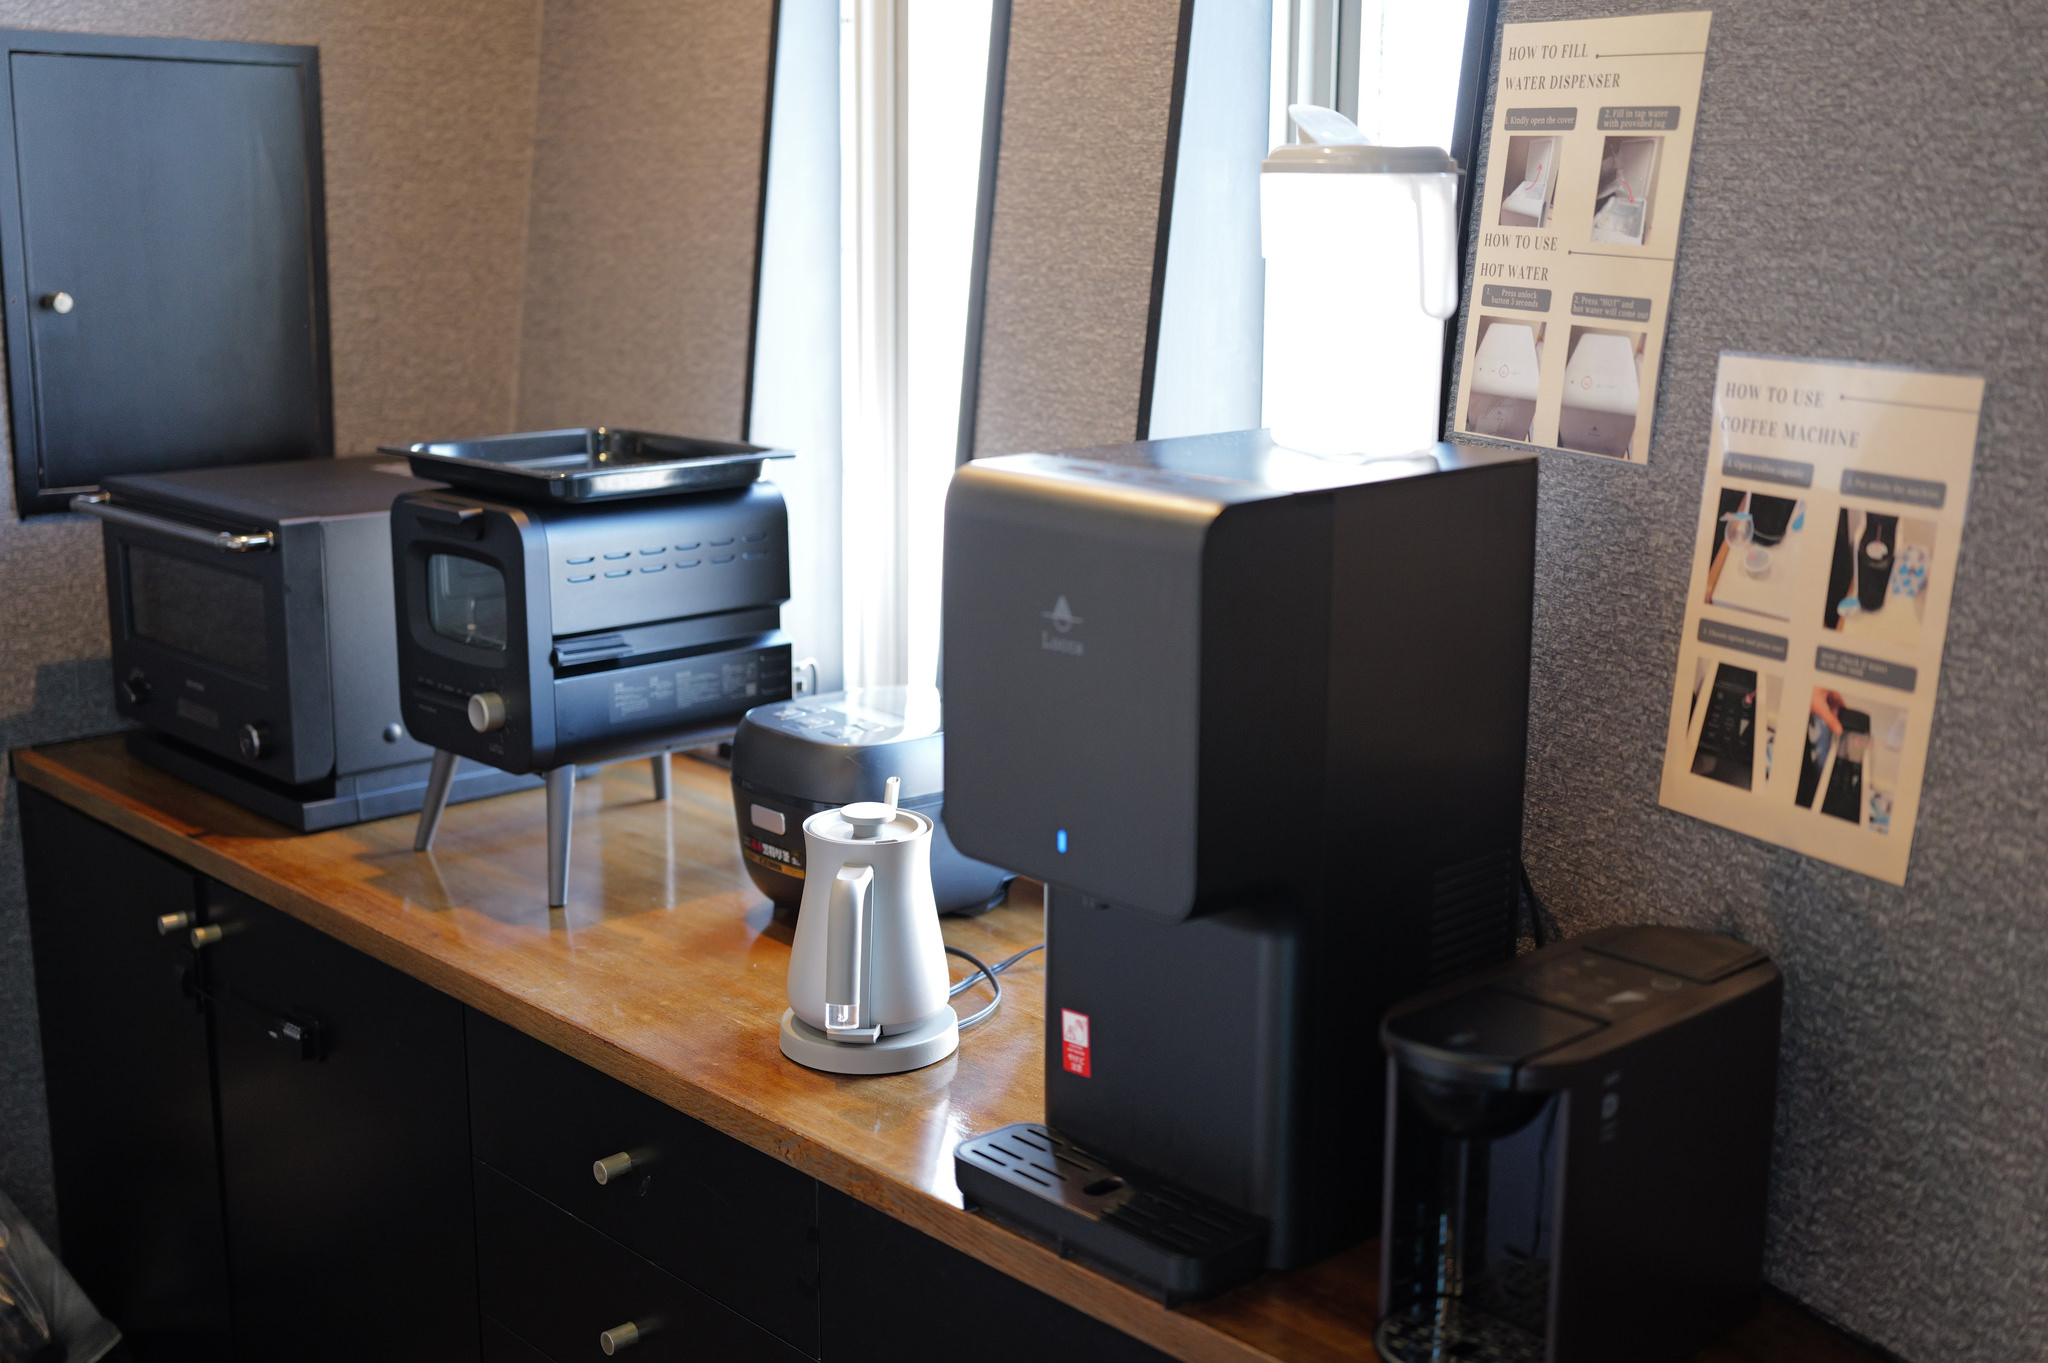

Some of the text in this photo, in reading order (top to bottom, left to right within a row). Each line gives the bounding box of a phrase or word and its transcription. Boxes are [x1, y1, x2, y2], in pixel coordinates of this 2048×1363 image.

[1508, 43, 1589, 61] HOW TO FILL
[1505, 73, 1621, 91] WATER DISPENSER
[1612, 108, 1624, 118] Fill
[1647, 110, 1669, 118] water
[1511, 115, 1529, 127] Kindly
[1530, 117, 1545, 126] open
[1546, 115, 1556, 125] the
[1557, 117, 1575, 125] cover
[1603, 118, 1619, 128] with
[1620, 118, 1653, 129] provided
[1484, 233, 1558, 251] HOW TO USE
[1480, 262, 1549, 281] HOT WATER
[1501, 288, 1517, 298] Press
[1517, 290, 1537, 299] unlock
[1581, 295, 1598, 306] Press
[1491, 295, 1510, 305] button
[1515, 298, 1539, 308] seconds
[1725, 381, 1825, 409] HOW TO USE
[1721, 415, 1860, 449] COFFEE MACHINE
